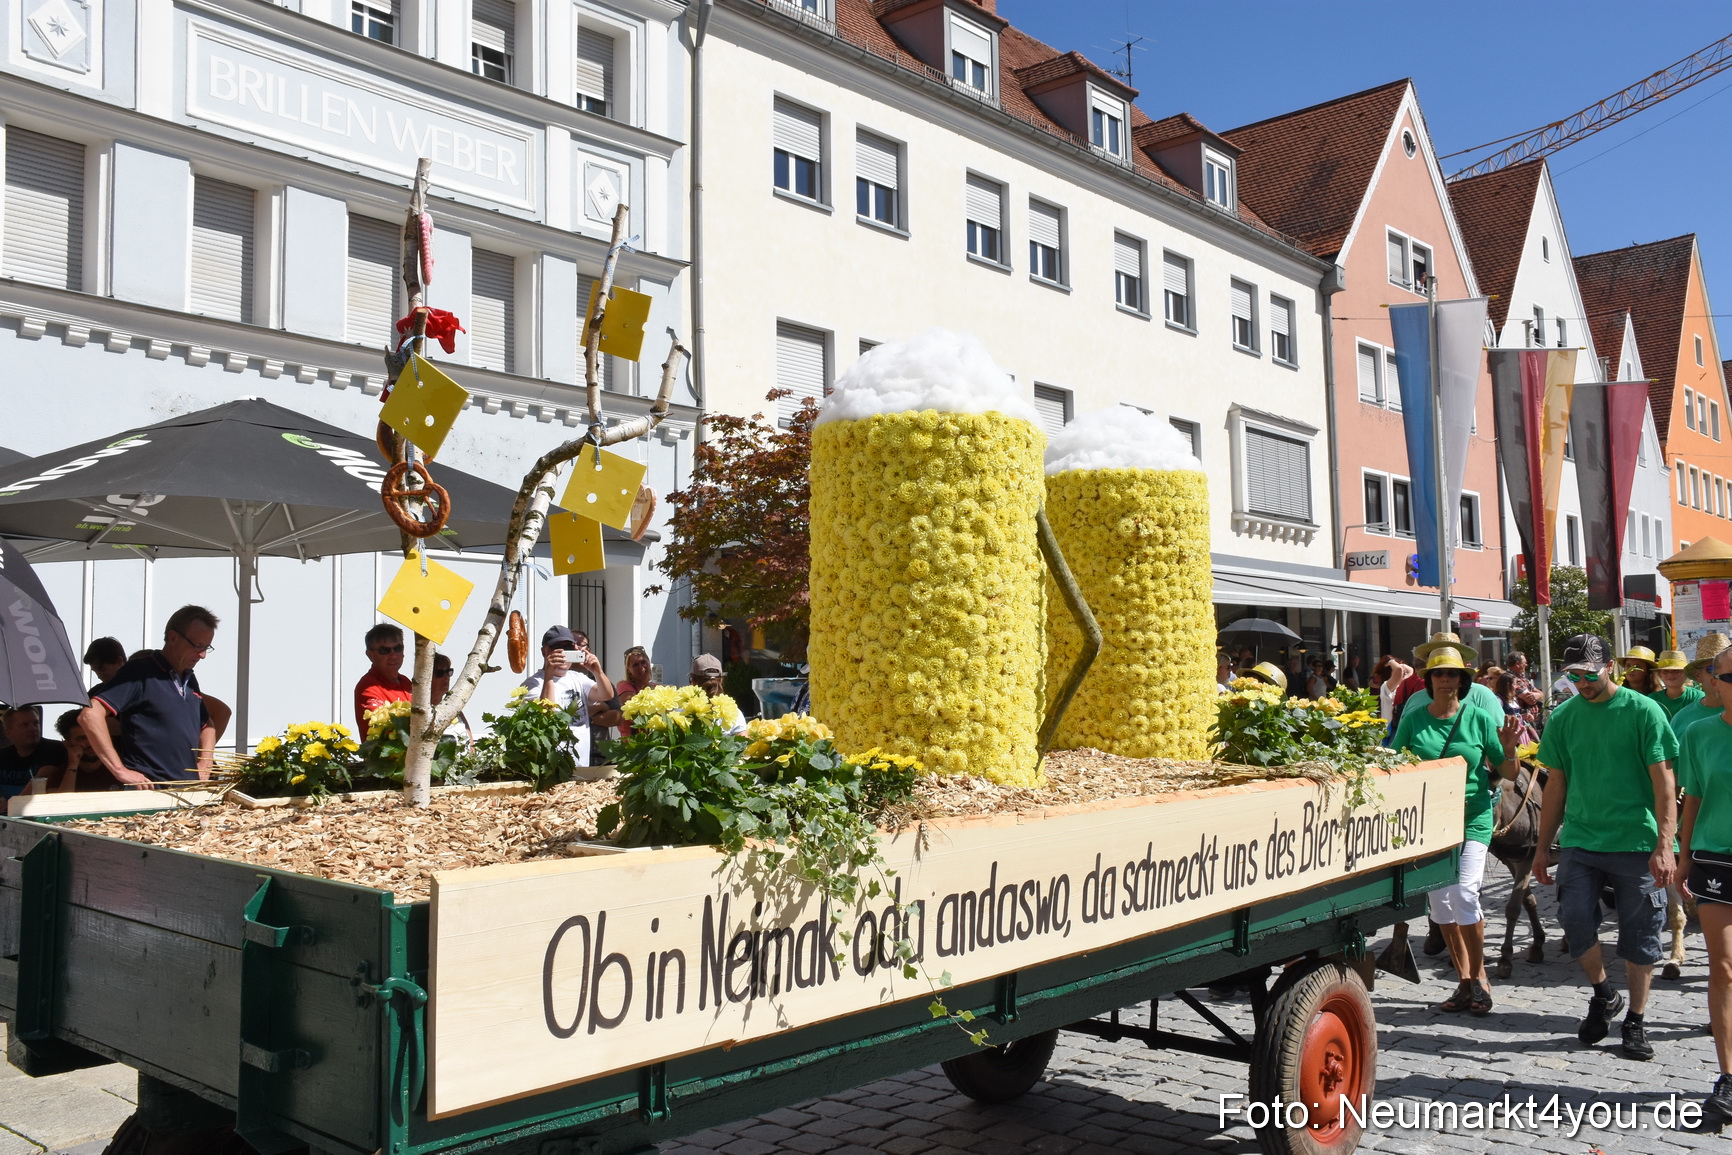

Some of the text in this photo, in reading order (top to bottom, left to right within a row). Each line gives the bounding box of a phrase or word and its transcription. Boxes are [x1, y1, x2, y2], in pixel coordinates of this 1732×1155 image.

[209, 54, 520, 187] BRILLEN WEBER
[542, 910, 634, 1040] Ob
[645, 917, 687, 1023] in
[698, 888, 841, 1011] Neimak
[853, 876, 926, 977] oda
[936, 860, 1072, 958] andaswo,
[1081, 852, 1118, 925] da
[1121, 832, 1219, 917] schmeckt
[1223, 837, 1259, 892] uns
[1264, 817, 1297, 881] des
[1299, 800, 1338, 875] Bier
[1345, 811, 1389, 873] genau
